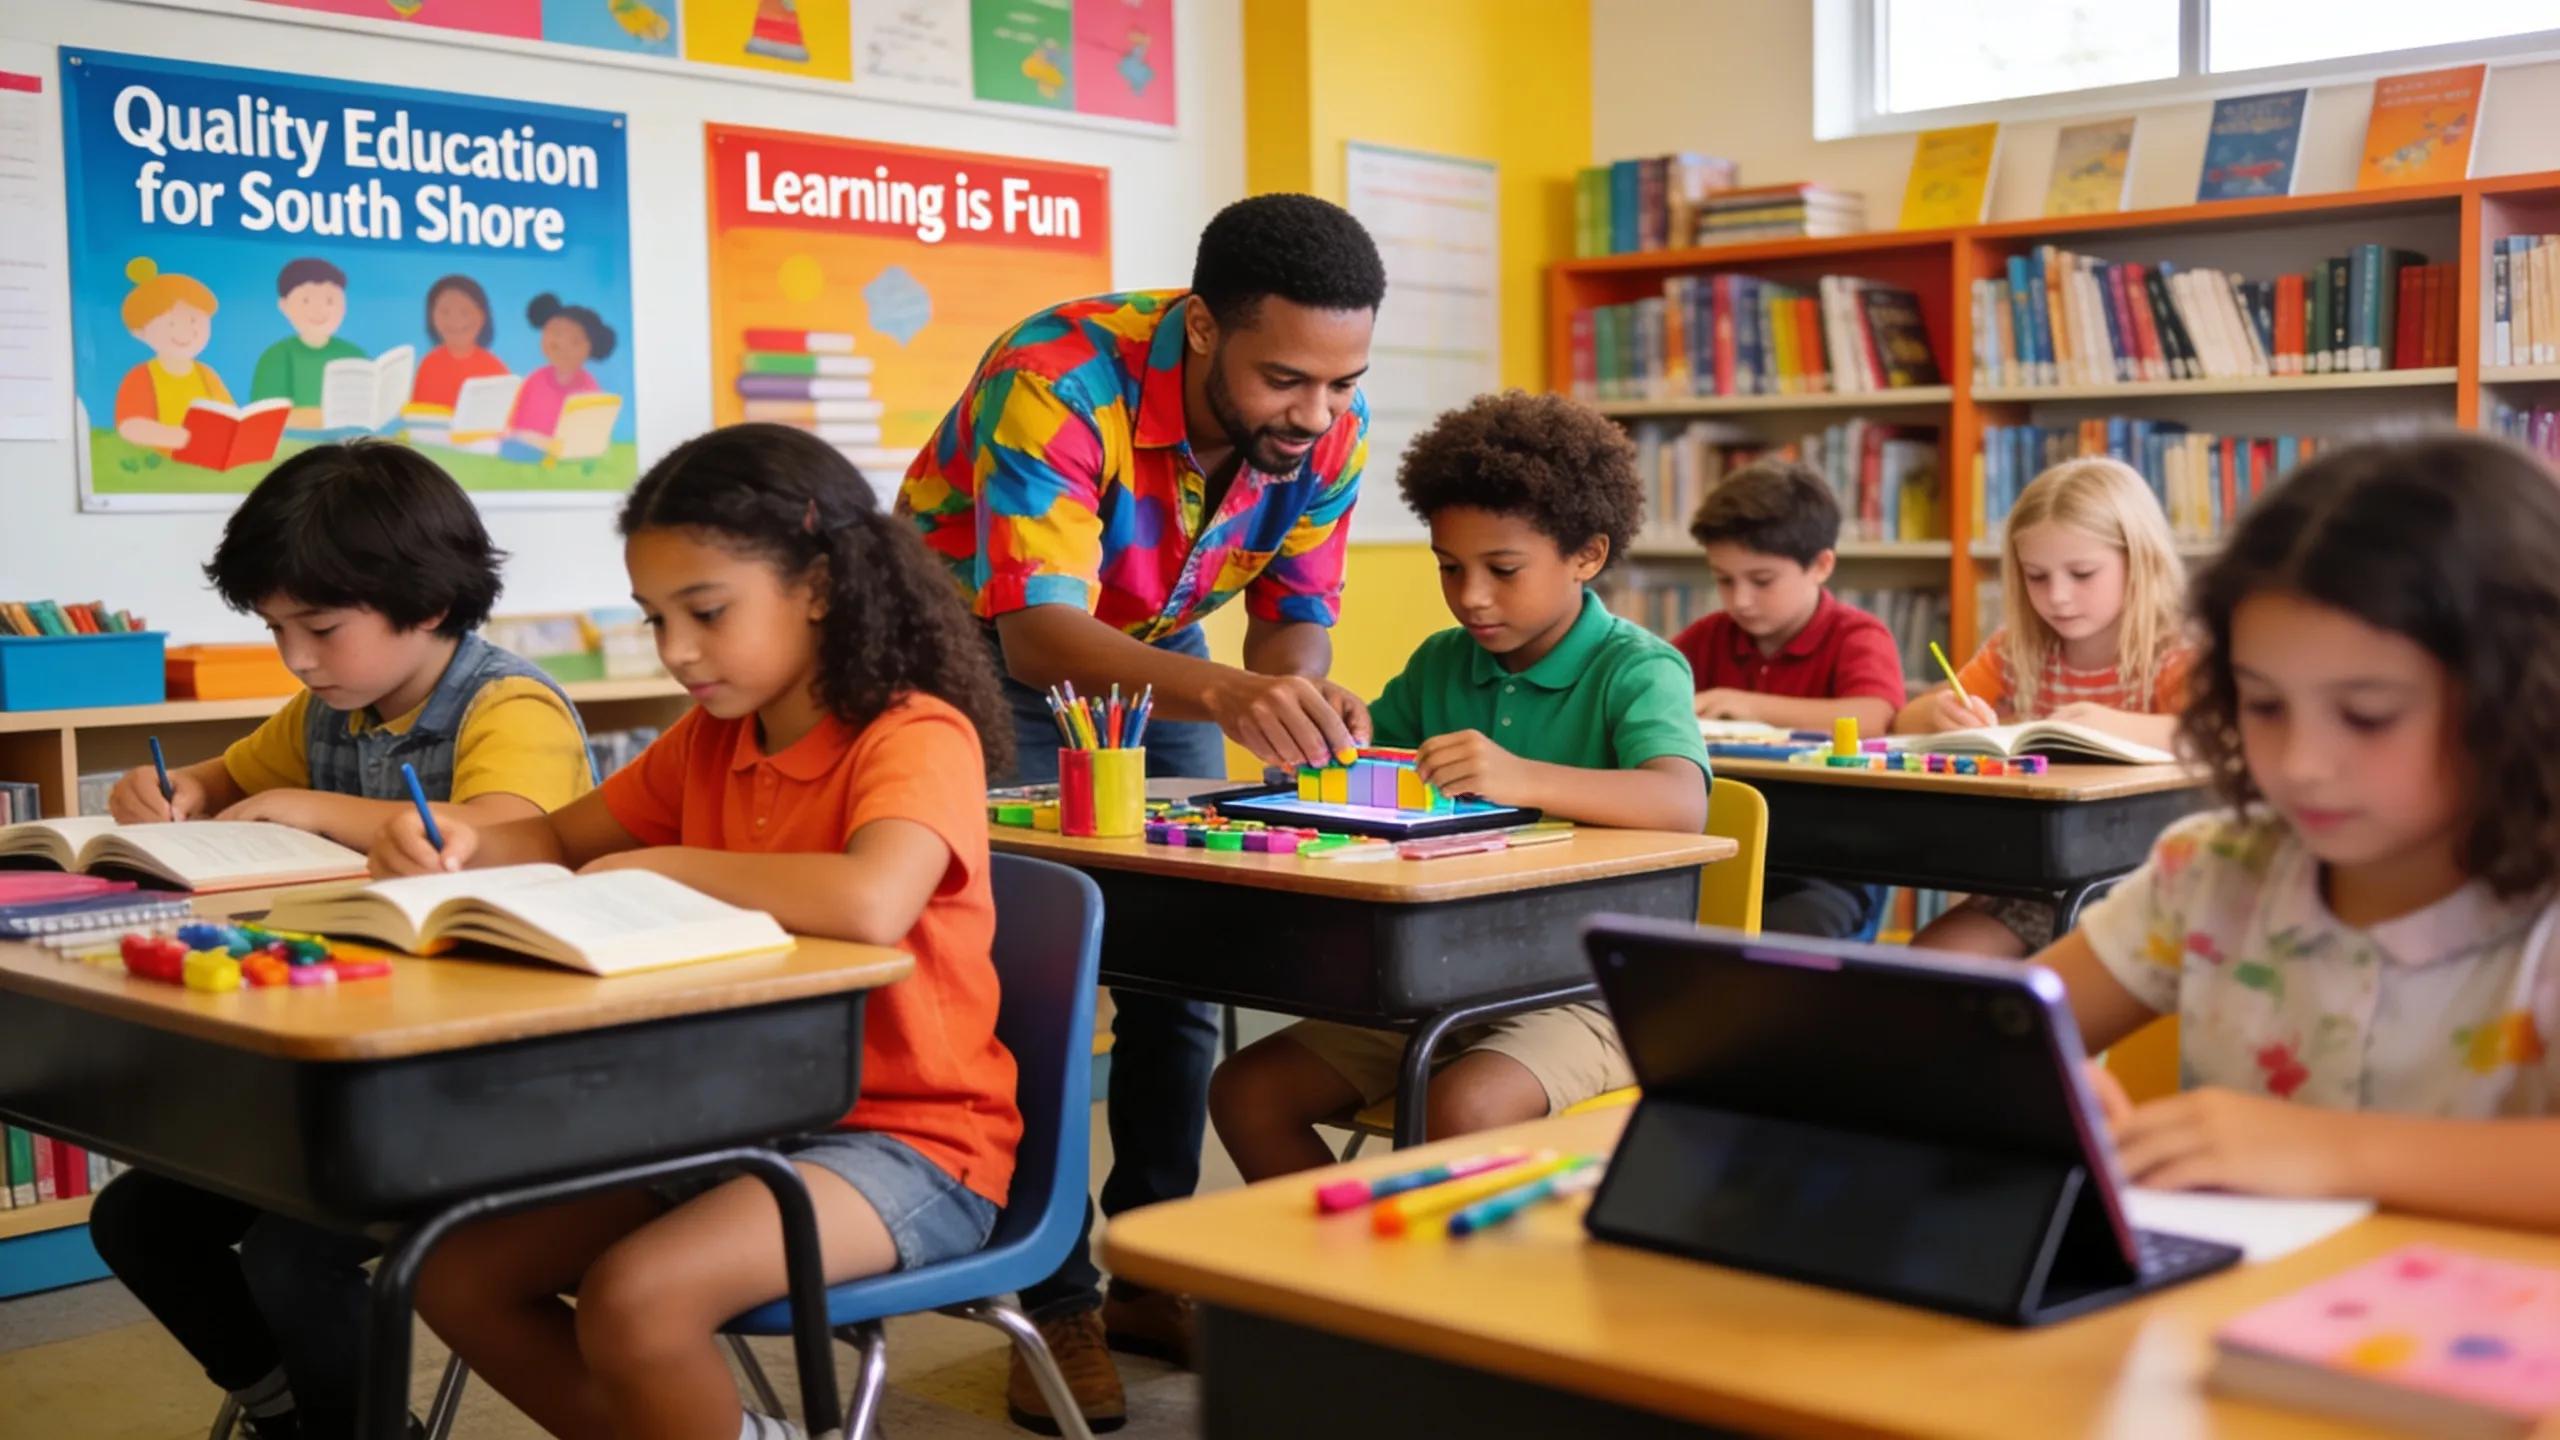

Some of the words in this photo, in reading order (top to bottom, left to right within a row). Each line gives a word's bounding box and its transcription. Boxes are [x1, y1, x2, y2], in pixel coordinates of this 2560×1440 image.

[114, 85, 328, 178] Quality
[344, 108, 598, 189] Education
[135, 161, 225, 226] for
[239, 170, 402, 240] South
[415, 185, 565, 251] Shore
[745, 151, 946, 243] Learning
[955, 172, 993, 231] is
[1002, 177, 1081, 239] Fun
